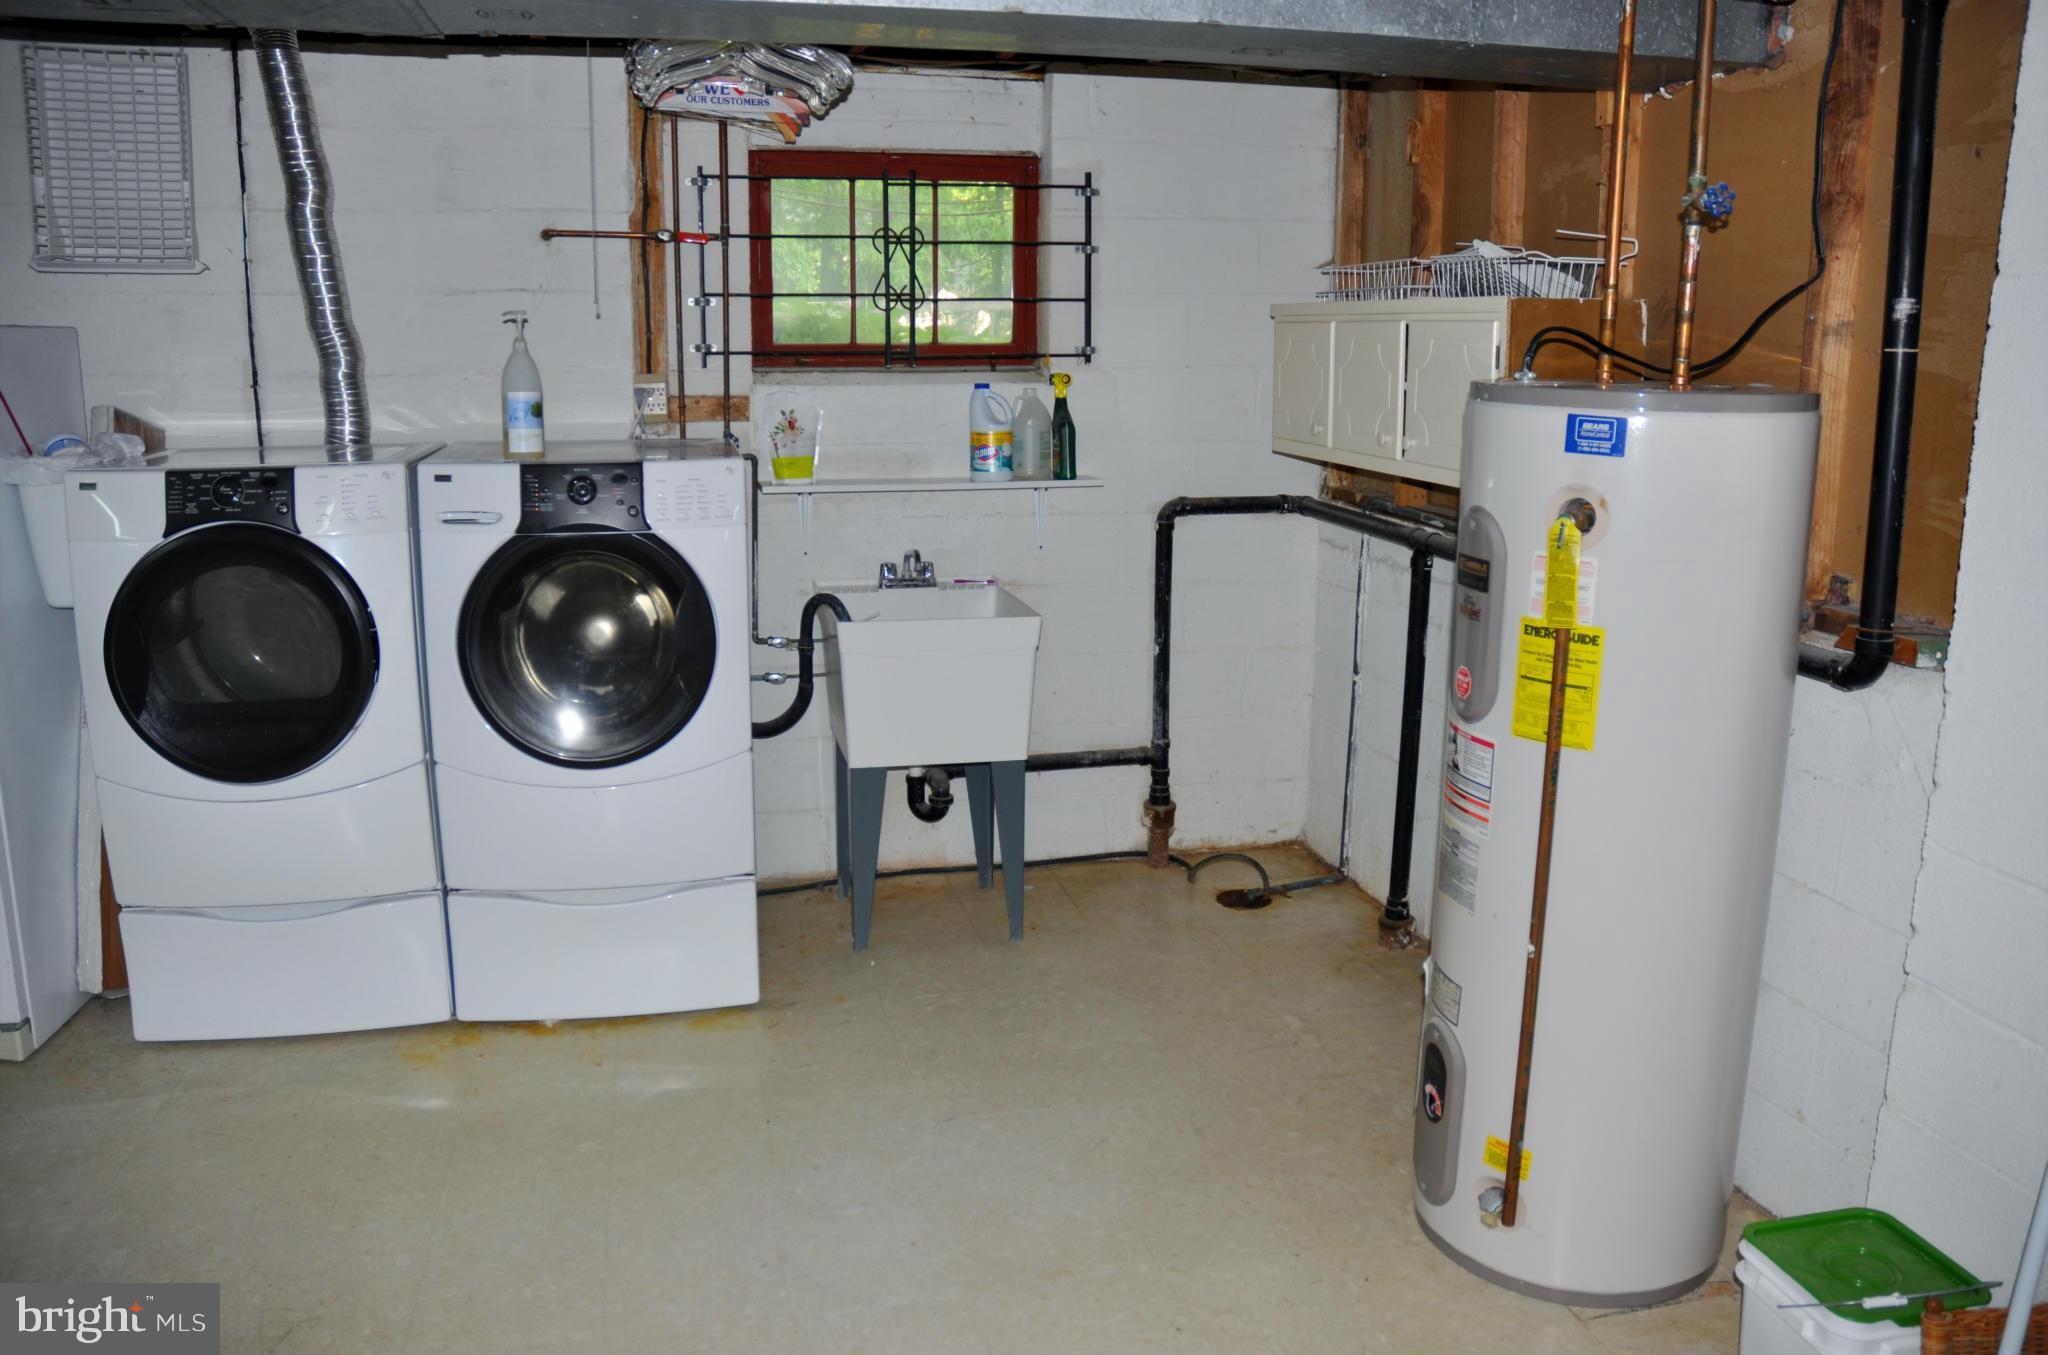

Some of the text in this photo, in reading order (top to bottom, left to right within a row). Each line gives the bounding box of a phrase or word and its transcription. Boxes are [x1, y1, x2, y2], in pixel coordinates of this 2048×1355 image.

[704, 84, 730, 96] WE
[686, 94, 770, 106] OUR CUSTOMERS
[1582, 422, 1610, 432] SEARS
